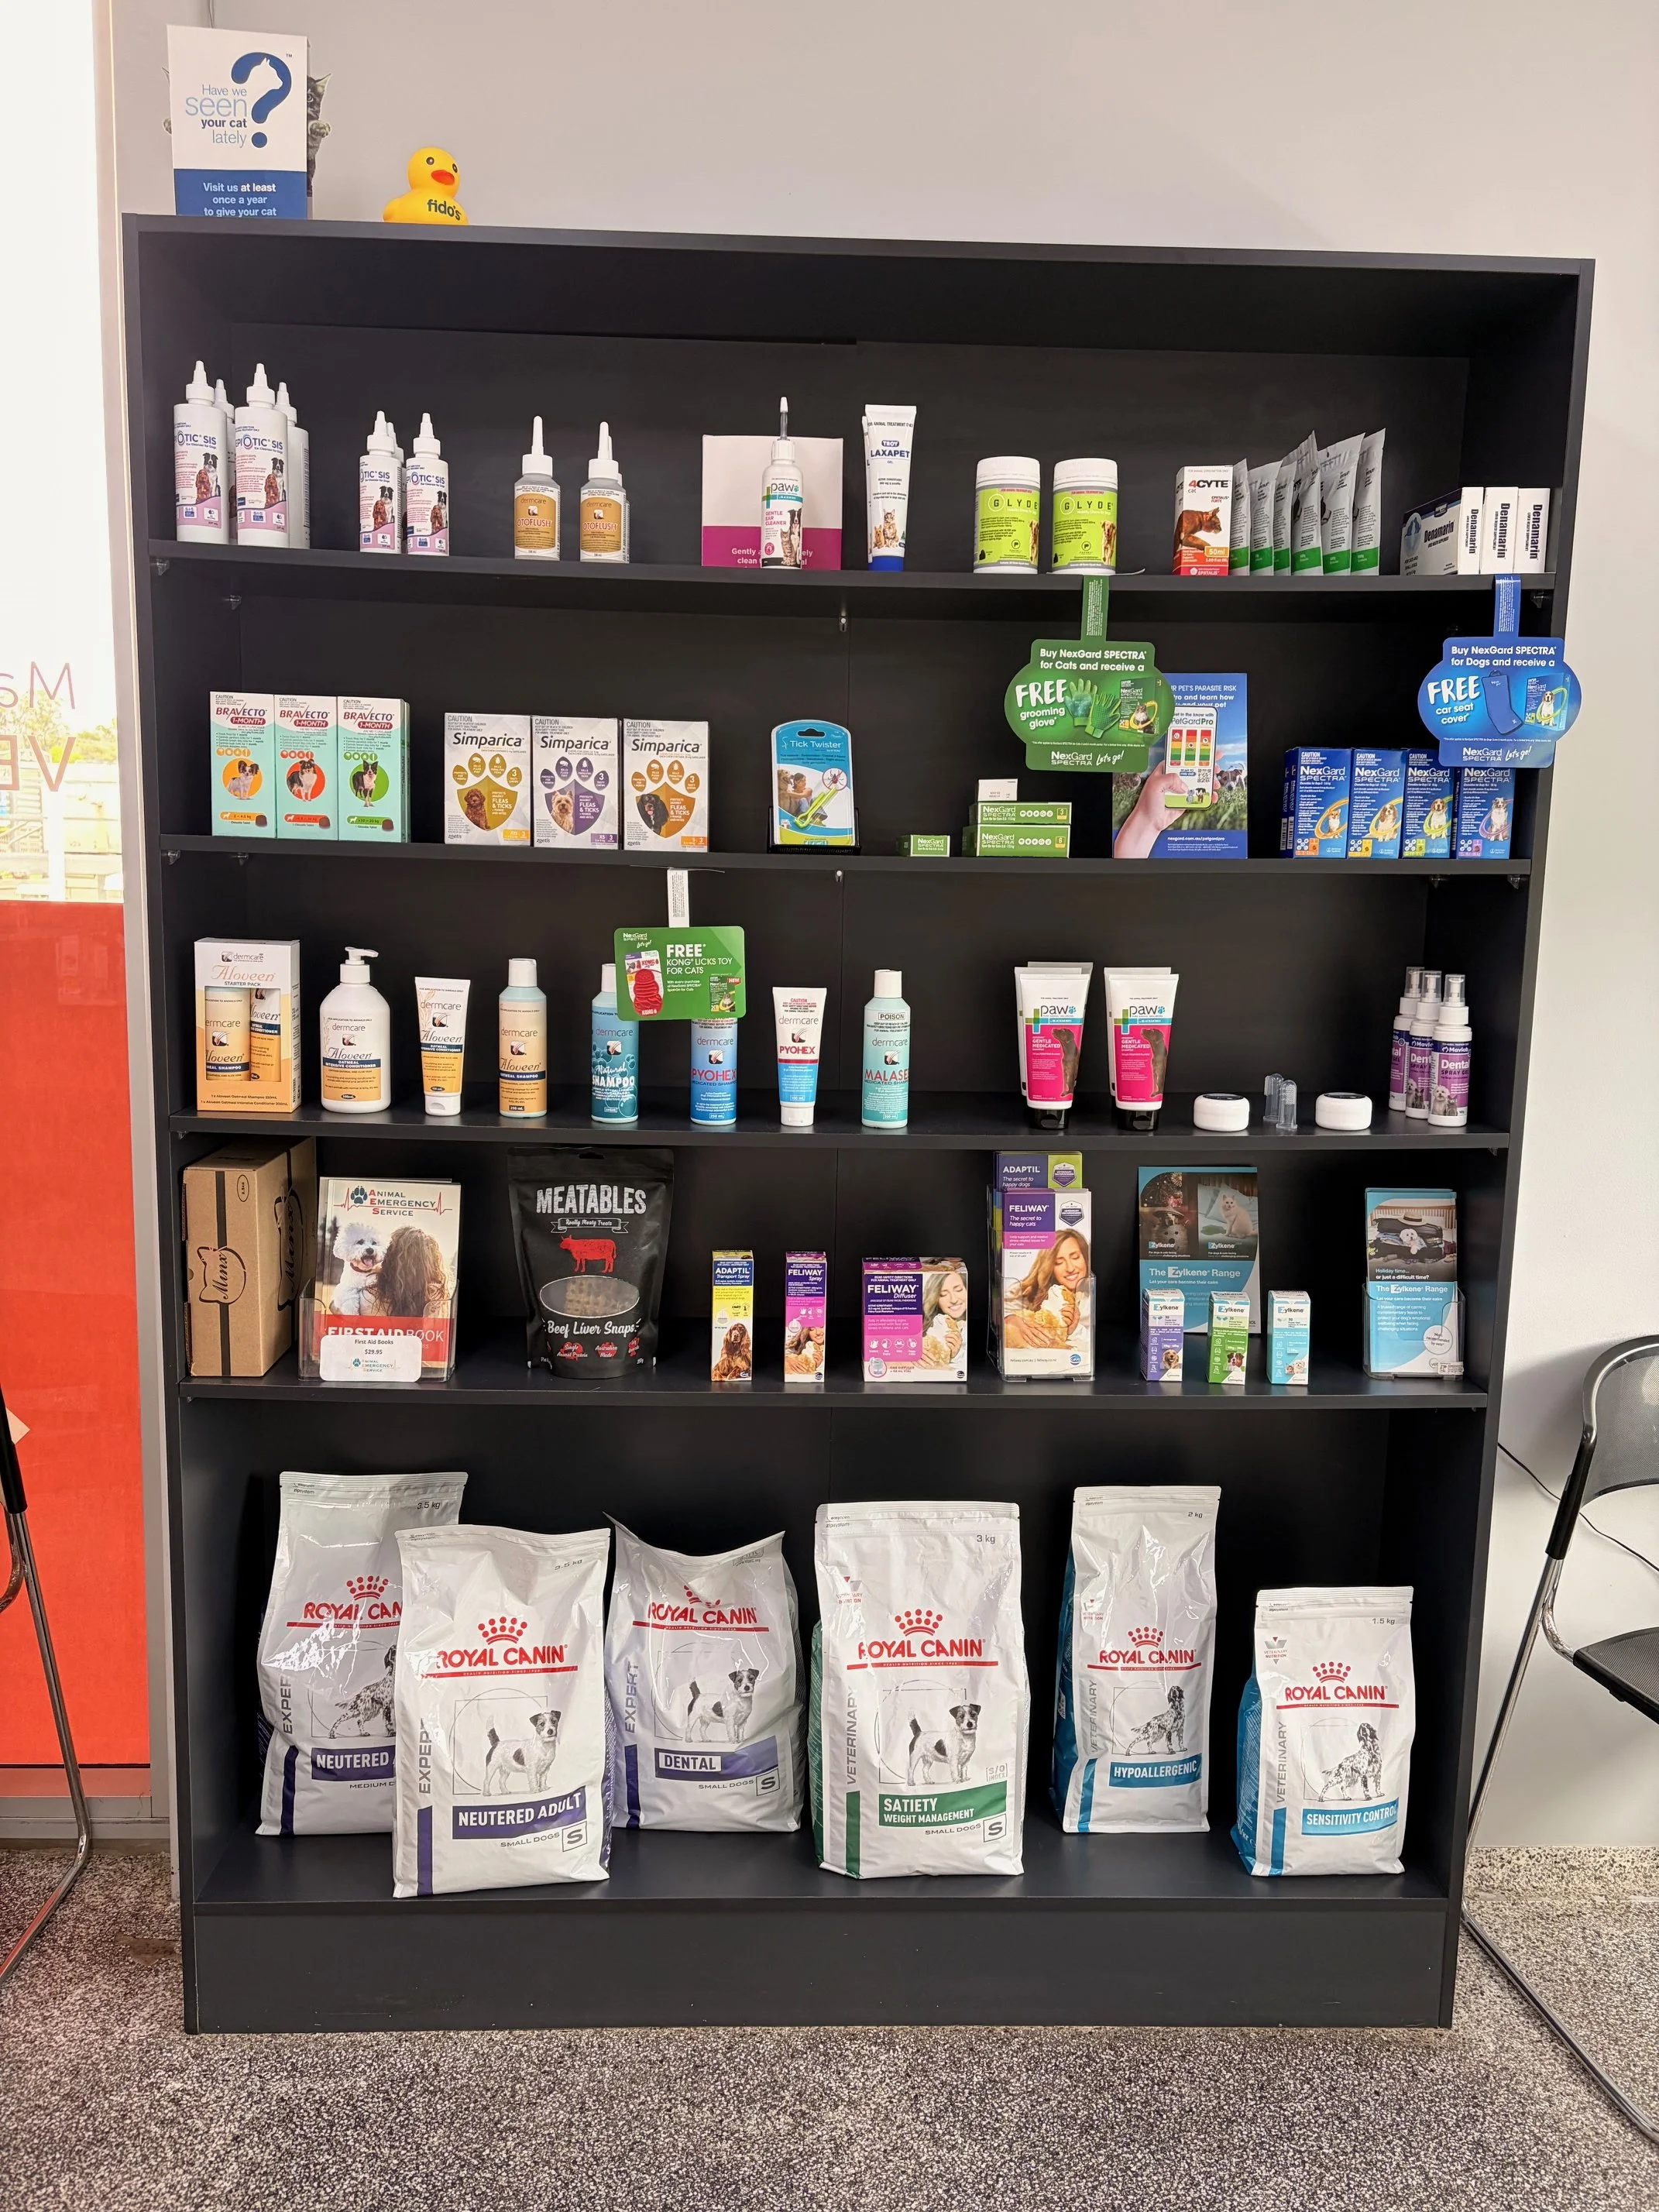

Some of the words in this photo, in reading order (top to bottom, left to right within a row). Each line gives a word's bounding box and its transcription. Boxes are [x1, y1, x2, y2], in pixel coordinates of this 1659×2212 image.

[202, 84, 228, 96] Have
[232, 88, 247, 96] we
[186, 97, 247, 116] seen
[201, 118, 225, 129] your
[229, 118, 247, 128] cat
[212, 130, 246, 148] lately
[203, 183, 225, 192] Visit
[241, 184, 250, 192] at
[252, 183, 276, 192] least
[246, 197, 267, 206] year
[204, 208, 215, 216] to
[217, 207, 235, 218] give
[239, 208, 257, 218] your
[259, 208, 276, 216] cat
[428, 198, 461, 221] fido's
[203, 436, 216, 445] SIS
[871, 449, 909, 458] LAXAPET
[771, 483, 795, 494] paw
[1189, 479, 1228, 488] 4CYTE
[1064, 501, 1111, 510] GLYDE
[1424, 521, 1455, 543] Denamarin
[1469, 509, 1479, 554] Denamarin
[1497, 503, 1510, 558] Denamarin
[1040, 648, 1056, 658] Buy
[1060, 650, 1101, 659] NexGard
[1104, 651, 1146, 660] SPECTRA
[1451, 646, 1468, 656] Buy
[1516, 647, 1555, 655] SPECTRA
[1040, 661, 1053, 669] for
[1055, 661, 1077, 670] Cats
[1080, 662, 1098, 671] and
[1101, 663, 1135, 672] receive
[1466, 658, 1490, 668] Dogs
[1016, 679, 1066, 707] FREE
[1427, 675, 1481, 705] FREE
[216, 706, 266, 717] BRAVECTO
[1020, 707, 1065, 720] grooming
[1454, 703, 1474, 713] seat
[280, 709, 328, 720] BRAVECTO
[453, 733, 522, 748] Simparica
[540, 736, 609, 752] Simparica
[791, 740, 809, 748] Tick
[1052, 751, 1092, 760] NexGard
[1097, 754, 1111, 765] Let's
[1113, 750, 1124, 764] go!
[1300, 765, 1345, 775] NexGard
[211, 964, 274, 982] Aloveen
[332, 1023, 366, 1032] dermcare
[595, 1062, 627, 1074] Natural
[1441, 1060, 1470, 1069] Dental
[692, 1070, 736, 1081] PYOHEX
[369, 1189, 406, 1198] ANIMAL
[536, 1184, 647, 1214] MEATABLES
[369, 1198, 436, 1207] EMERGENCY
[372, 1207, 414, 1217] SERVICE
[1168, 1266, 1207, 1277] Zylkene
[1211, 1269, 1240, 1278] Range
[548, 1321, 570, 1338] Beef
[573, 1321, 601, 1334] Liver
[604, 1321, 635, 1338] Snaps
[436, 1648, 498, 1668] ROYAL
[503, 1645, 564, 1665] CANIN
[316, 1753, 389, 1769] NEUTERED
[664, 1756, 716, 1771] DENTAL
[1114, 1759, 1197, 1778] HYPOALLERGENIC
[538, 1792, 581, 1819] ADULT
[884, 1798, 937, 1812] SATIETY
[884, 1813, 916, 1823] WEIGHT
[918, 1808, 974, 1822] MANAGEMENT
[1307, 1813, 1362, 1826] SENSITIVITY
[500, 1839, 532, 1848] SMALL
[534, 1832, 560, 1842] DOGS
